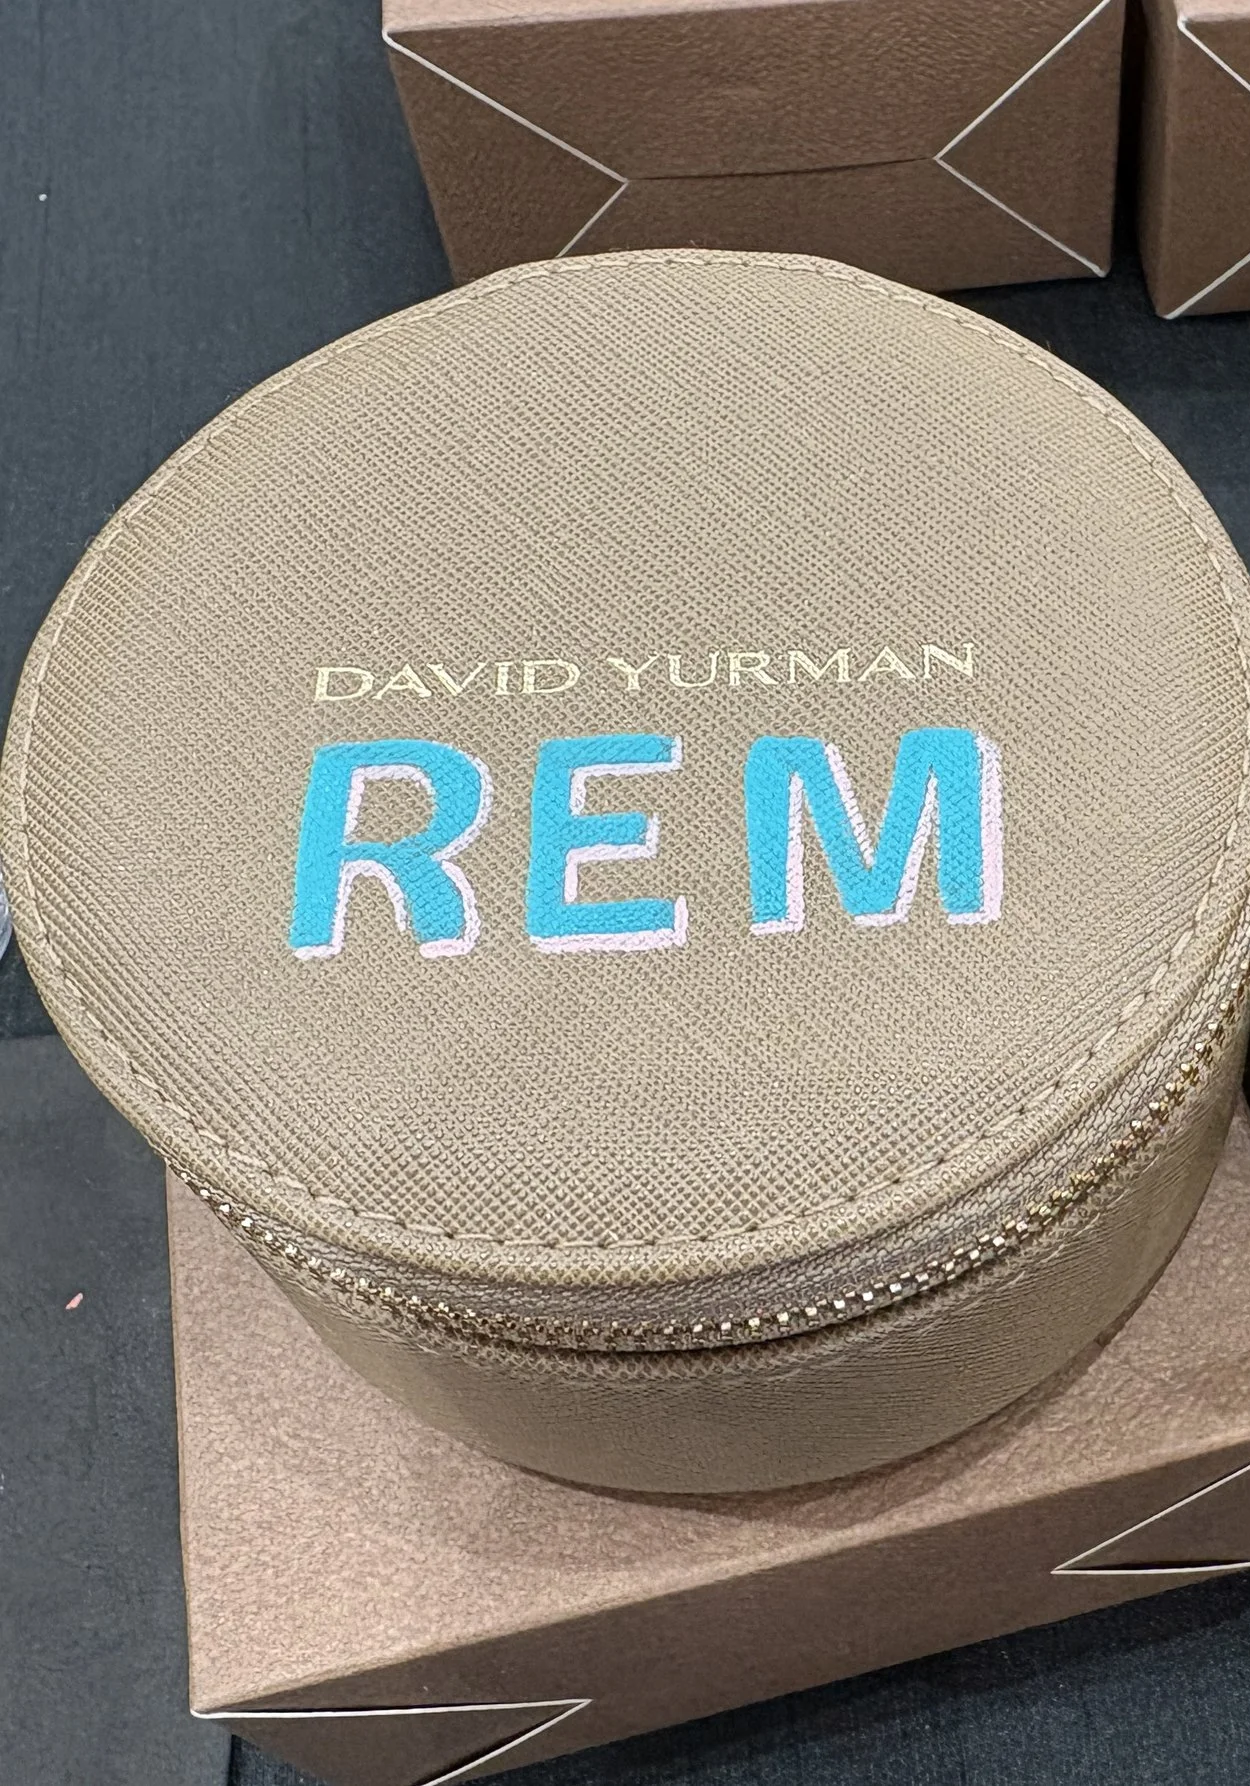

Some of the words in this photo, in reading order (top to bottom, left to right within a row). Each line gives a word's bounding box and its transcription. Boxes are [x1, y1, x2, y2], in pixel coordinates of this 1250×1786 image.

[313, 658, 582, 702] DAVID
[607, 641, 977, 691] YURMAN
[288, 726, 1004, 959] REM
